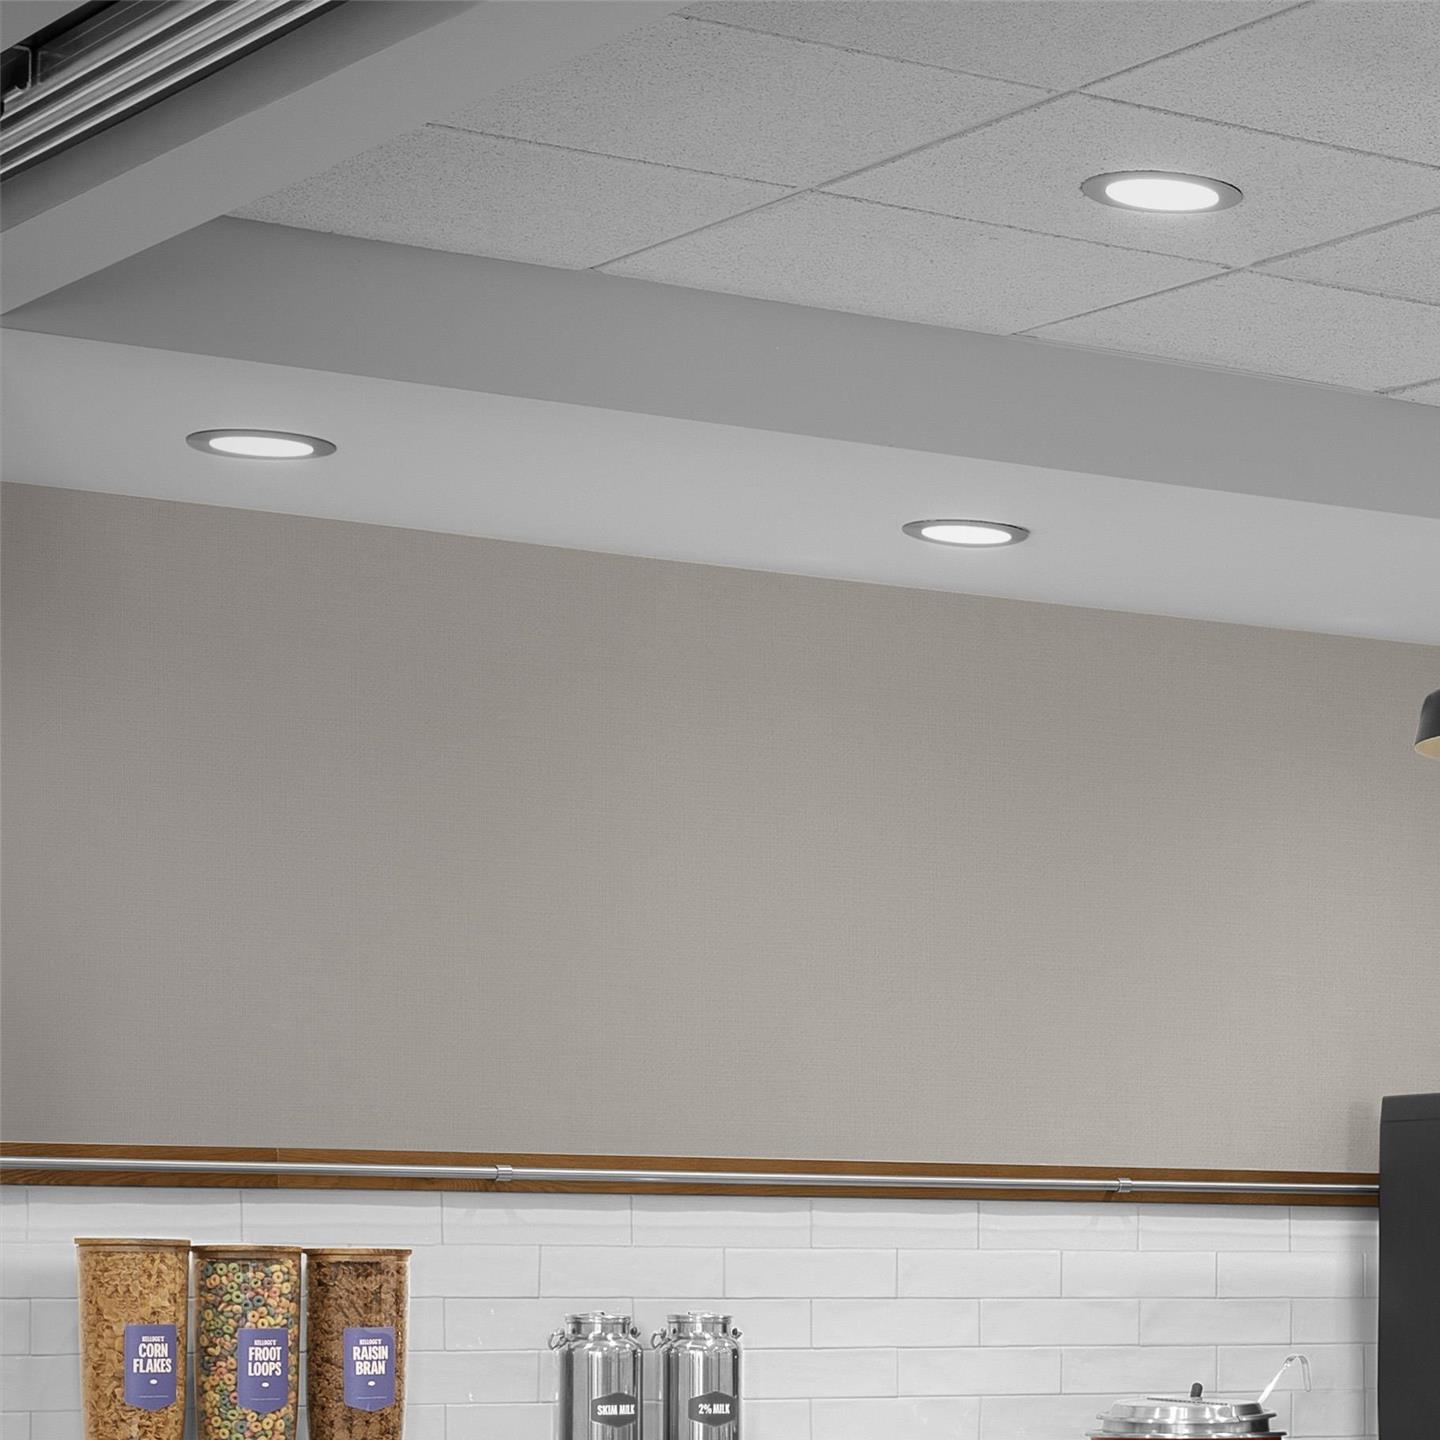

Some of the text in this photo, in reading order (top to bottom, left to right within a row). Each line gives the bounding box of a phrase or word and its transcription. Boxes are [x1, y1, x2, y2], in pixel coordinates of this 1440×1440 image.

[138, 1343, 168, 1358] CORN
[248, 1346, 282, 1361] FROOT
[352, 1345, 389, 1361] RAISIN
[133, 1358, 172, 1374] FLAKES
[247, 1361, 282, 1377] LOOPS
[355, 1361, 386, 1376] BRAN
[597, 1404, 635, 1416] SKIM MILK
[698, 1403, 731, 1415] 2% MILK
